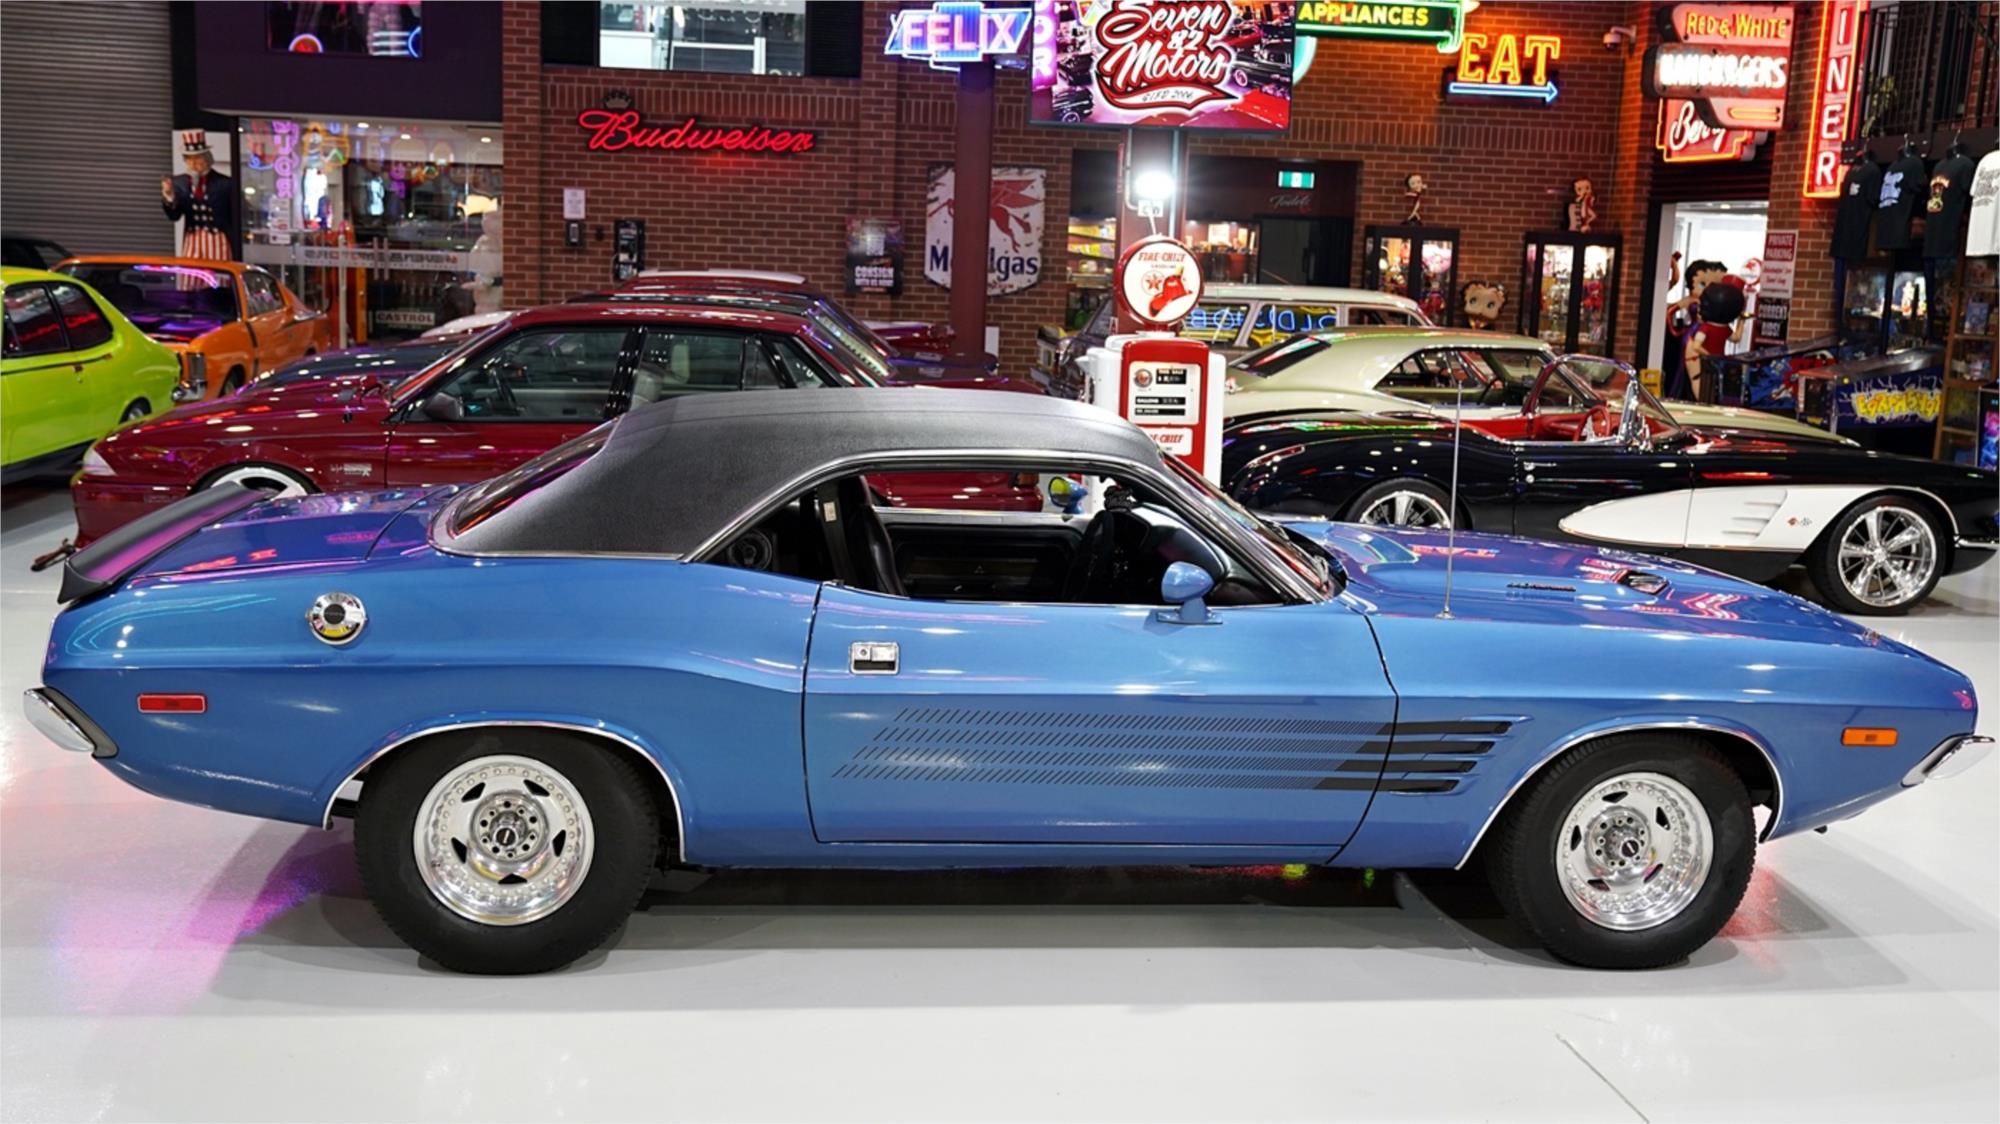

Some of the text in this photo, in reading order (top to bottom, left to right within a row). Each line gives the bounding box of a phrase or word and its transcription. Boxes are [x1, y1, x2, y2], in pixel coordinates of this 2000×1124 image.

[902, 13, 1017, 52] FELIX
[1102, 0, 1225, 45] Seven
[1298, 4, 1429, 26] APPLIANCES
[1687, 12, 1787, 38] RED & WHITE
[1167, 30, 1204, 50] 82
[1457, 33, 1561, 85] EAT
[1103, 40, 1224, 88] Motors
[578, 110, 814, 152] Budweiser
[376, 311, 433, 322] CASTROL
